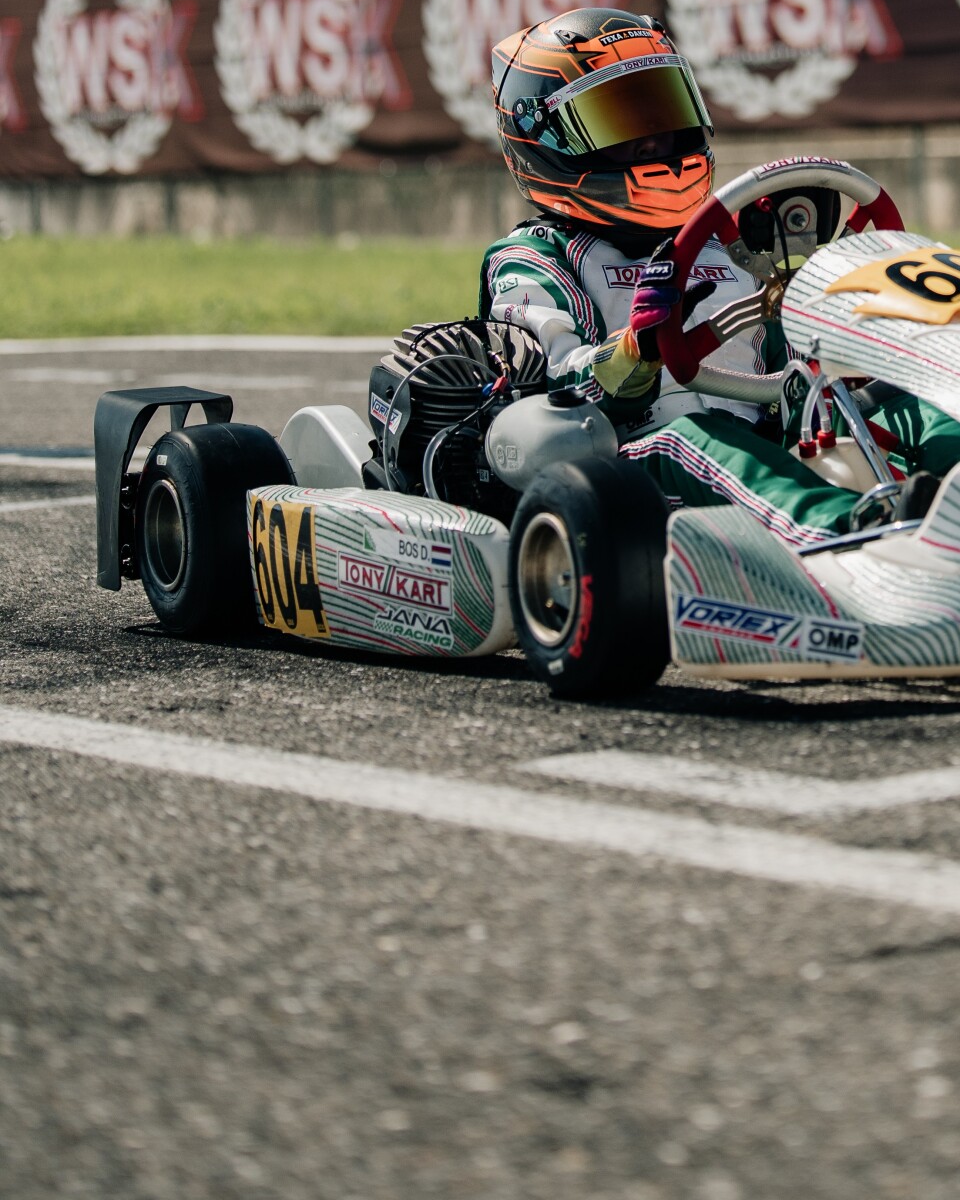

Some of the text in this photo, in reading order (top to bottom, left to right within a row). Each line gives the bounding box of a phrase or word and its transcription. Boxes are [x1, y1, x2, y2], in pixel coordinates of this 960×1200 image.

[600, 33, 623, 45] TEXA
[622, 60, 644, 71] TONY
[690, 265, 728, 280] ART
[372, 396, 399, 422] VORTX
[399, 540, 431, 562] BOS D.
[252, 499, 327, 634] 604
[340, 555, 449, 606] TONY KART
[377, 607, 451, 635] JANA
[677, 595, 795, 636] VORTEX
[393, 625, 453, 648] RACING
[808, 628, 860, 651] OMP
